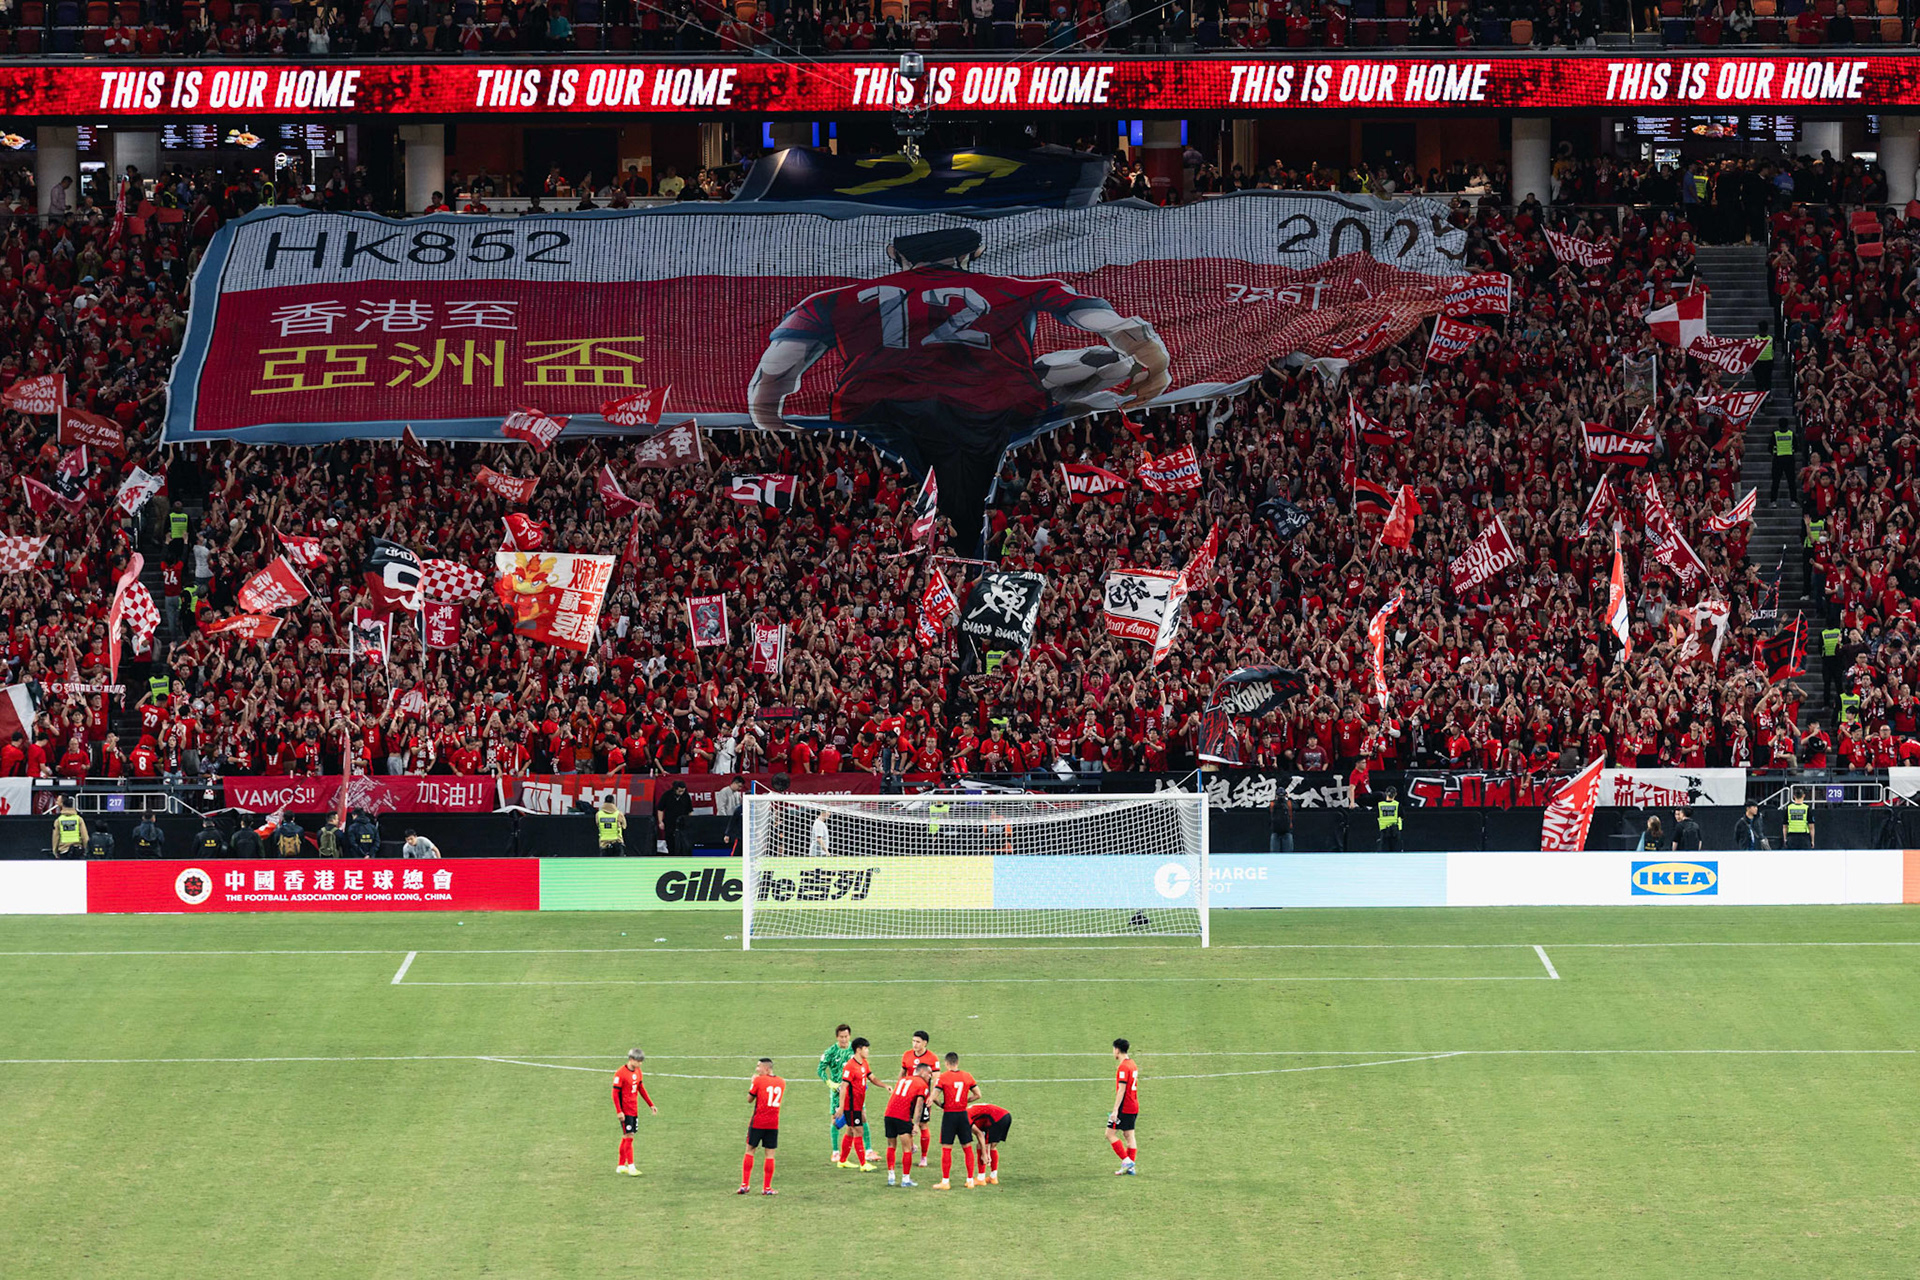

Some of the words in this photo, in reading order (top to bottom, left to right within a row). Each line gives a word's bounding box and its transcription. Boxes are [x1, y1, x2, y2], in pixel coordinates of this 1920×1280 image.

[96, 71, 164, 108] THIS
[171, 71, 202, 108] IS
[210, 71, 267, 108] OUR
[275, 70, 360, 107] HOME
[473, 69, 540, 106] THIS
[548, 69, 579, 106] IS
[586, 69, 644, 106] OUR
[651, 69, 737, 105] HOME
[852, 68, 915, 105] THIS
[924, 68, 955, 104] IS
[963, 67, 1020, 104] OUR
[1028, 66, 1113, 103] HOME
[1228, 66, 1293, 102] THIS
[1301, 65, 1332, 102] IS
[1339, 65, 1397, 101] OUR
[1404, 64, 1490, 101] HOME
[1605, 63, 1671, 100] THIS
[1678, 63, 1709, 99] IS
[1716, 63, 1775, 99] OUR
[1782, 62, 1867, 98] HOME
[264, 230, 572, 270] HK852
[270, 299, 519, 338] 香港至
[857, 284, 991, 350] 12
[250, 335, 647, 396] 亞洲盃
[66, 418, 96, 435] HONG
[95, 424, 121, 441] KONG
[1588, 434, 1654, 454] WAHK
[163, 571, 178, 586] 24
[691, 597, 710, 606] BRING
[712, 595, 722, 604] ON
[143, 712, 158, 728] 29
[138, 756, 146, 771] 8
[109, 798, 122, 807] 217
[234, 787, 315, 807] VAMOS!!
[416, 780, 483, 807] 加油!!
[1828, 788, 1843, 798] 219
[225, 869, 453, 891] 中國香港足球總會
[1209, 866, 1268, 880] HARGE
[1639, 871, 1709, 886] IKEA
[797, 868, 874, 901] 吉列
[1207, 882, 1233, 893] POT
[225, 894, 242, 902] THE
[244, 894, 289, 902] FOOTBALL
[365, 893, 391, 901] HONG
[393, 893, 423, 902] KONG,
[424, 893, 452, 901] CHINA
[766, 1085, 782, 1108] 12
[893, 1077, 914, 1098] 11
[953, 1081, 964, 1103] 7
